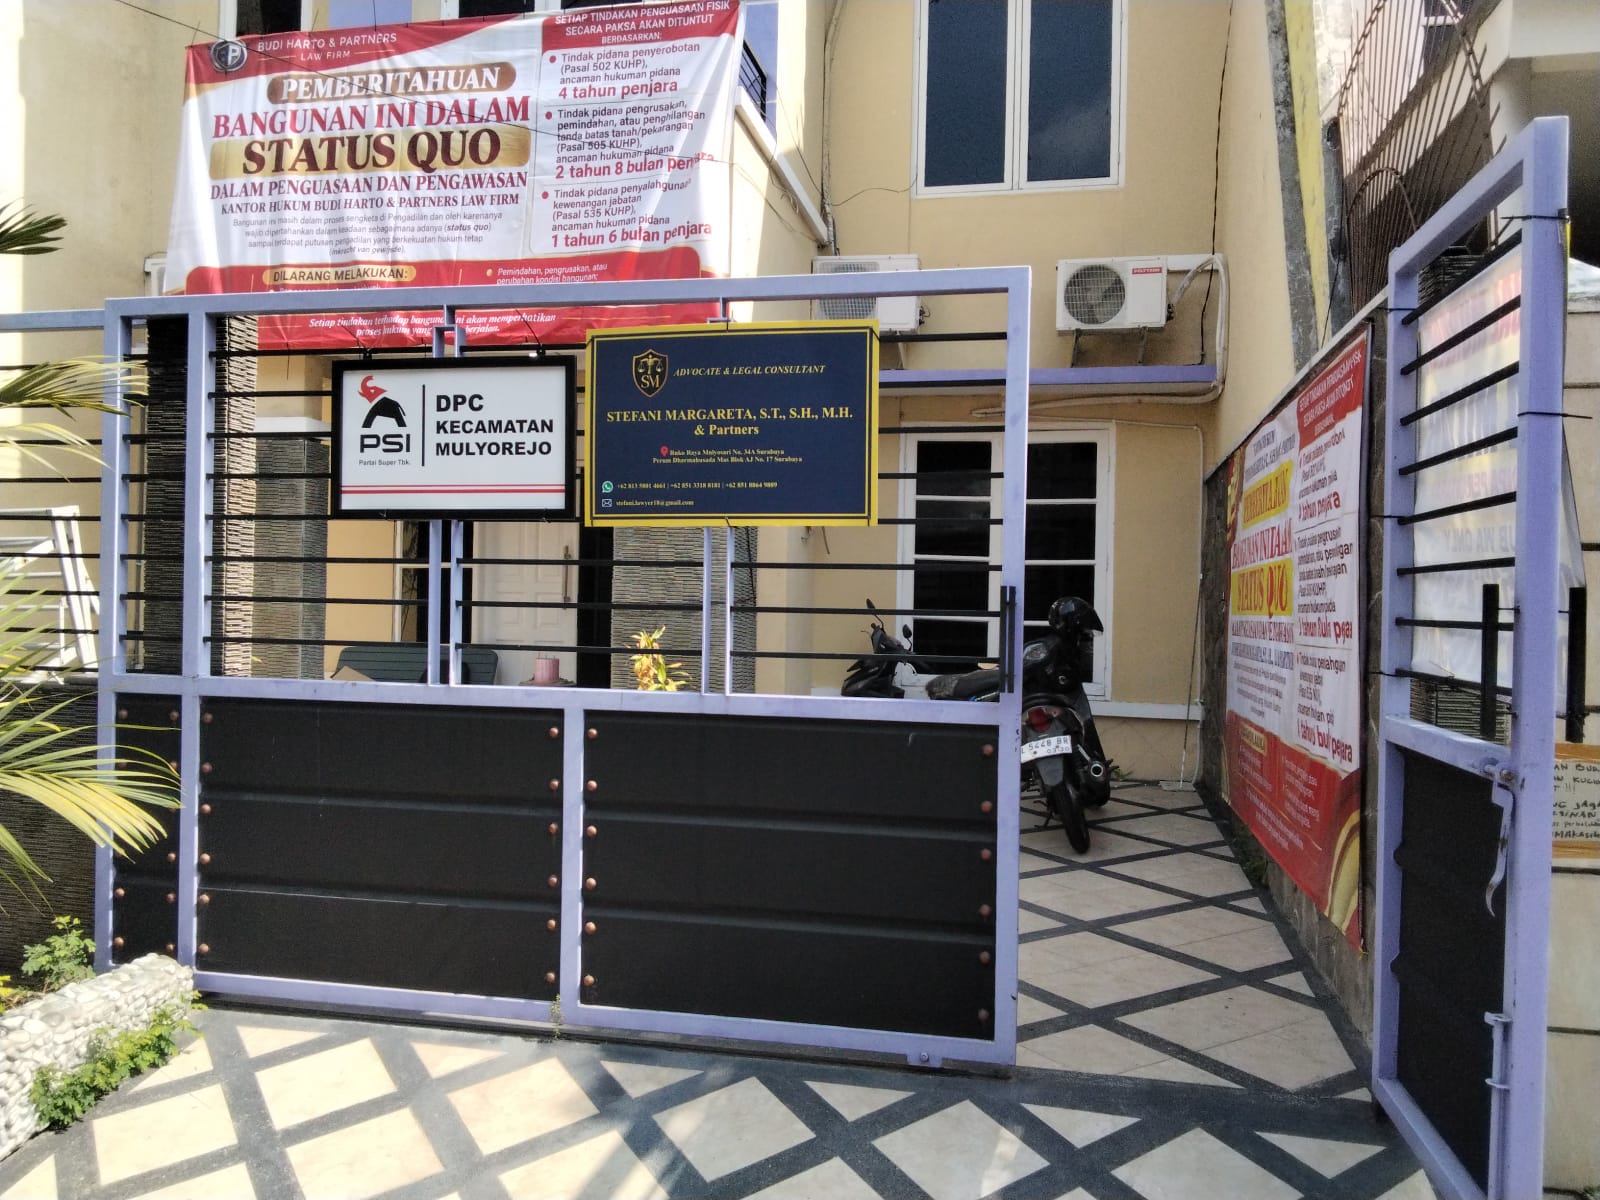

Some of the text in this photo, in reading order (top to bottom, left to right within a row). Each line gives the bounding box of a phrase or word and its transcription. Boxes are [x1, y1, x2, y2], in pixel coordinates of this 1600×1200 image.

[555, 1, 730, 25] SETIAP TINDAKAN PENGUASAAN FISIK
[566, 14, 714, 36] SECARA PAKSA AKAN DITUNTUT
[258, 32, 397, 52] BUDI HARTO & PARTNERS
[300, 50, 350, 61] LAW FIRM
[562, 43, 700, 62] Tindak pidana penyerobotan
[560, 59, 648, 75] (Pasal 502 KUHP),
[560, 67, 681, 85] ancaman hukuman pidana
[280, 67, 500, 101] PEMBERITAHUAN
[559, 80, 678, 99] 4 tahun penjara
[213, 96, 530, 138] BANGUNAN INI DALAM
[558, 100, 688, 119] Tindak pidana pengrusakan,
[558, 111, 706, 131] pemindahan, atau penghilangan
[585, 129, 610, 140] batas
[612, 122, 694, 139] tanah/pekarangan
[242, 128, 501, 175] STATUS QUO
[556, 142, 585, 154] (Pasal
[610, 138, 643, 150] KUHP),
[556, 144, 674, 164] ancaman hukuman pidana
[556, 157, 664, 179] 2 tahun 8 bulan
[211, 172, 528, 199] DALAM PENGUASAAN DAN PENGAWASAN
[554, 184, 619, 200] Tindak pidana
[221, 193, 520, 215] KANTOR HUKUM BUDI HARTO & PARTNERS LAW FIRM
[554, 194, 642, 210] kewenangan jabatan
[234, 218, 267, 227] Bangunan
[300, 216, 322, 224] dalam
[430, 212, 443, 221] dan
[552, 205, 637, 223] (Pasal 535 KUHP),
[552, 214, 670, 232] ancaman hukuman pidana
[552, 222, 712, 248] 1 tahun 6 bulan penjara
[274, 267, 408, 282] DILARANG MELAKUKAN:
[309, 318, 336, 329] Setiap
[466, 314, 488, 324] akan
[412, 327, 432, 336] yang
[673, 365, 826, 377] ADVOCATE & LEGAL CONSULTANT
[436, 394, 484, 412] DPC
[607, 406, 853, 422] STEFANI MARGARETA, S.T., S.H., M.H.
[436, 420, 554, 434] KECAMATAN
[694, 424, 759, 436] & Partners
[360, 434, 410, 454] PSI
[436, 441, 552, 457] MULYOREJO
